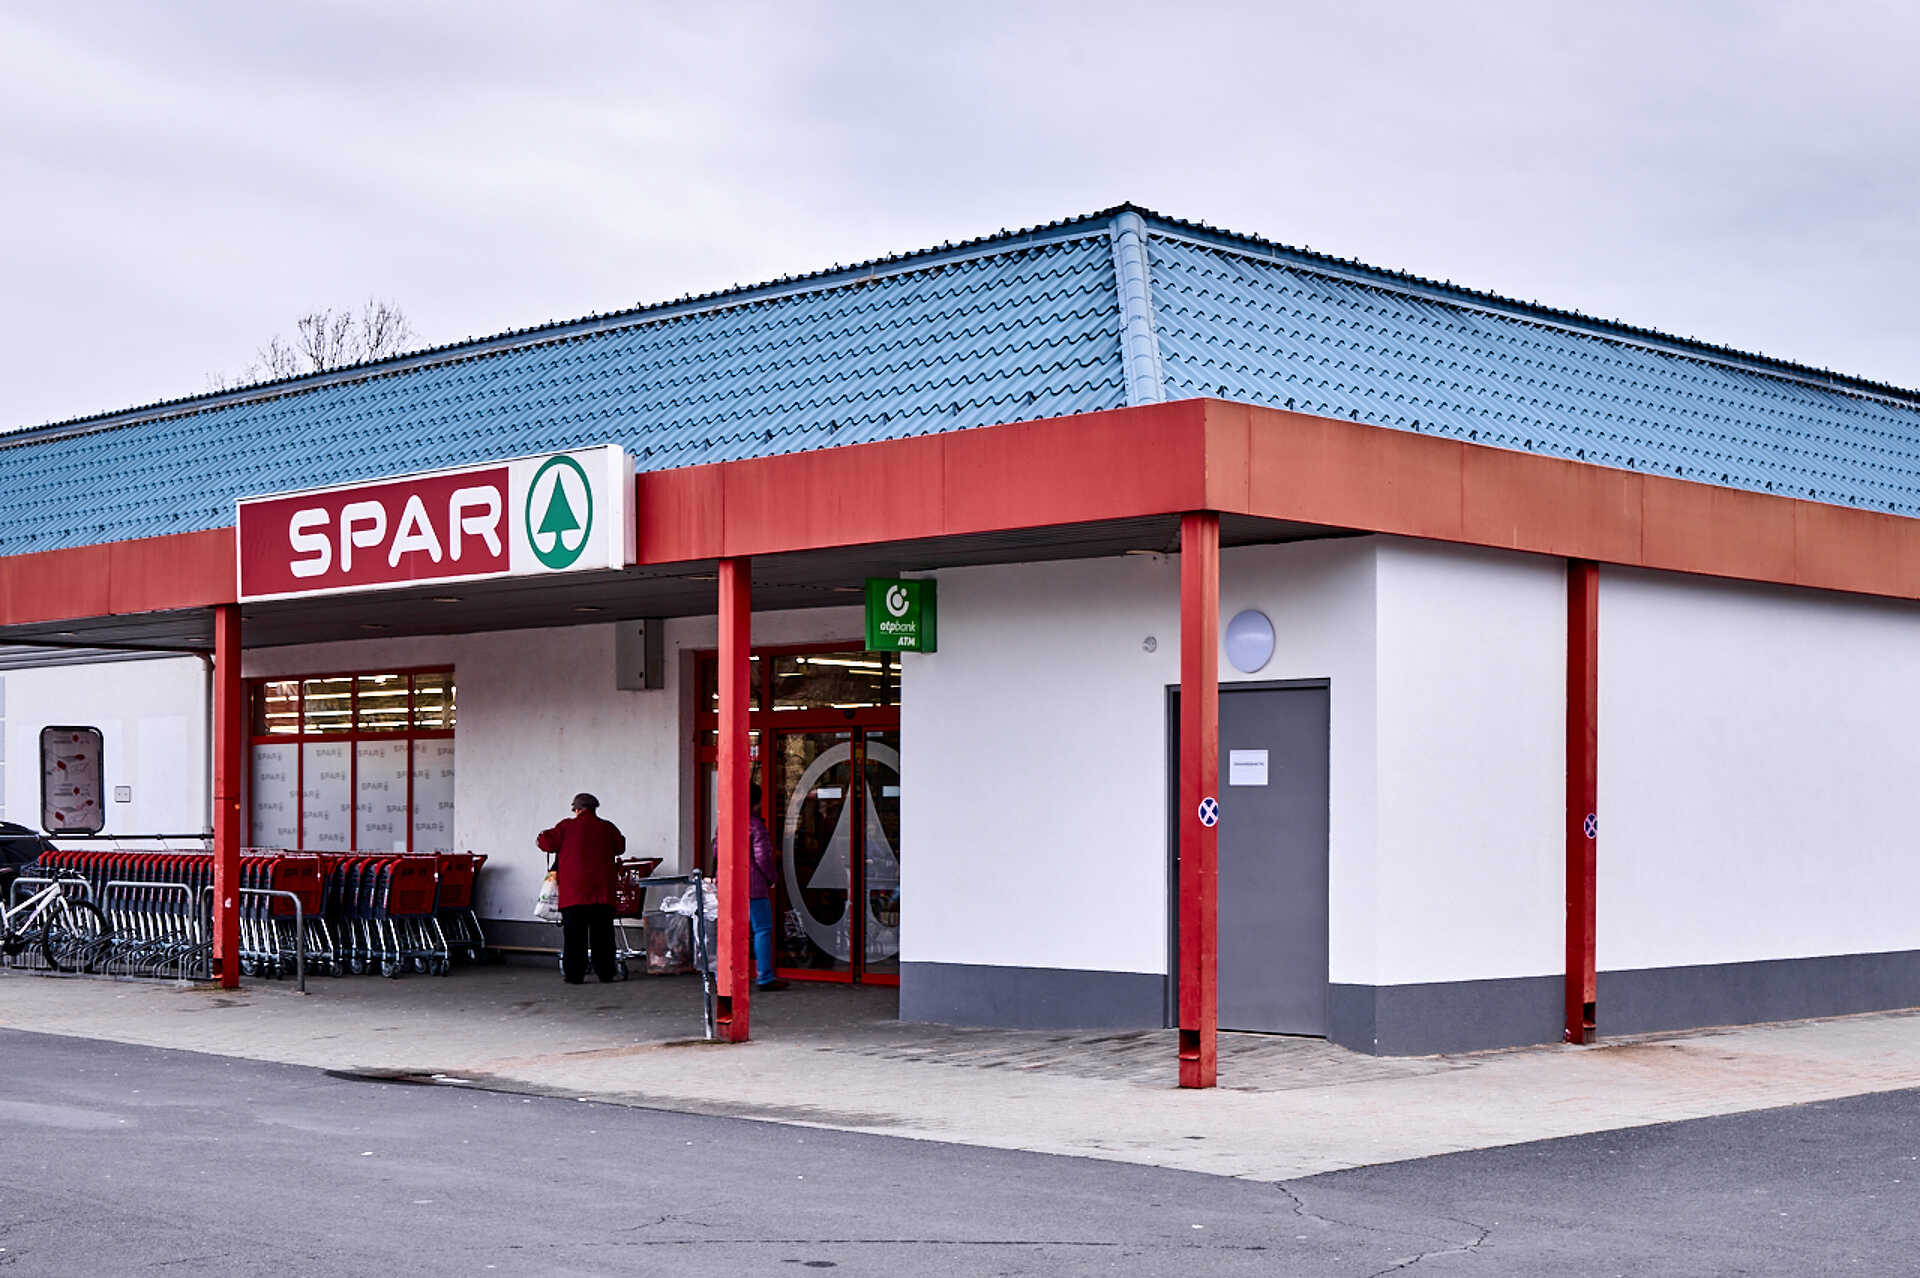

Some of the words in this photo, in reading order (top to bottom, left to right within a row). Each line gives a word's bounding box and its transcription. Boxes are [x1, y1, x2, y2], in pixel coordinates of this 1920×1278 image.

[289, 485, 502, 578] SPAR
[897, 636, 916, 647] ATM
[257, 752, 278, 761] SPAR
[316, 749, 337, 757] SPAR
[358, 749, 379, 758] SPAR
[260, 773, 280, 781] SPAR
[320, 771, 341, 780] SPAR
[361, 782, 383, 791] SPAR
[258, 802, 278, 811] SPAR
[303, 810, 324, 819] SPAR
[366, 823, 388, 832] SPAR
[415, 822, 438, 832] SPAR
[319, 833, 340, 842] SPAR
